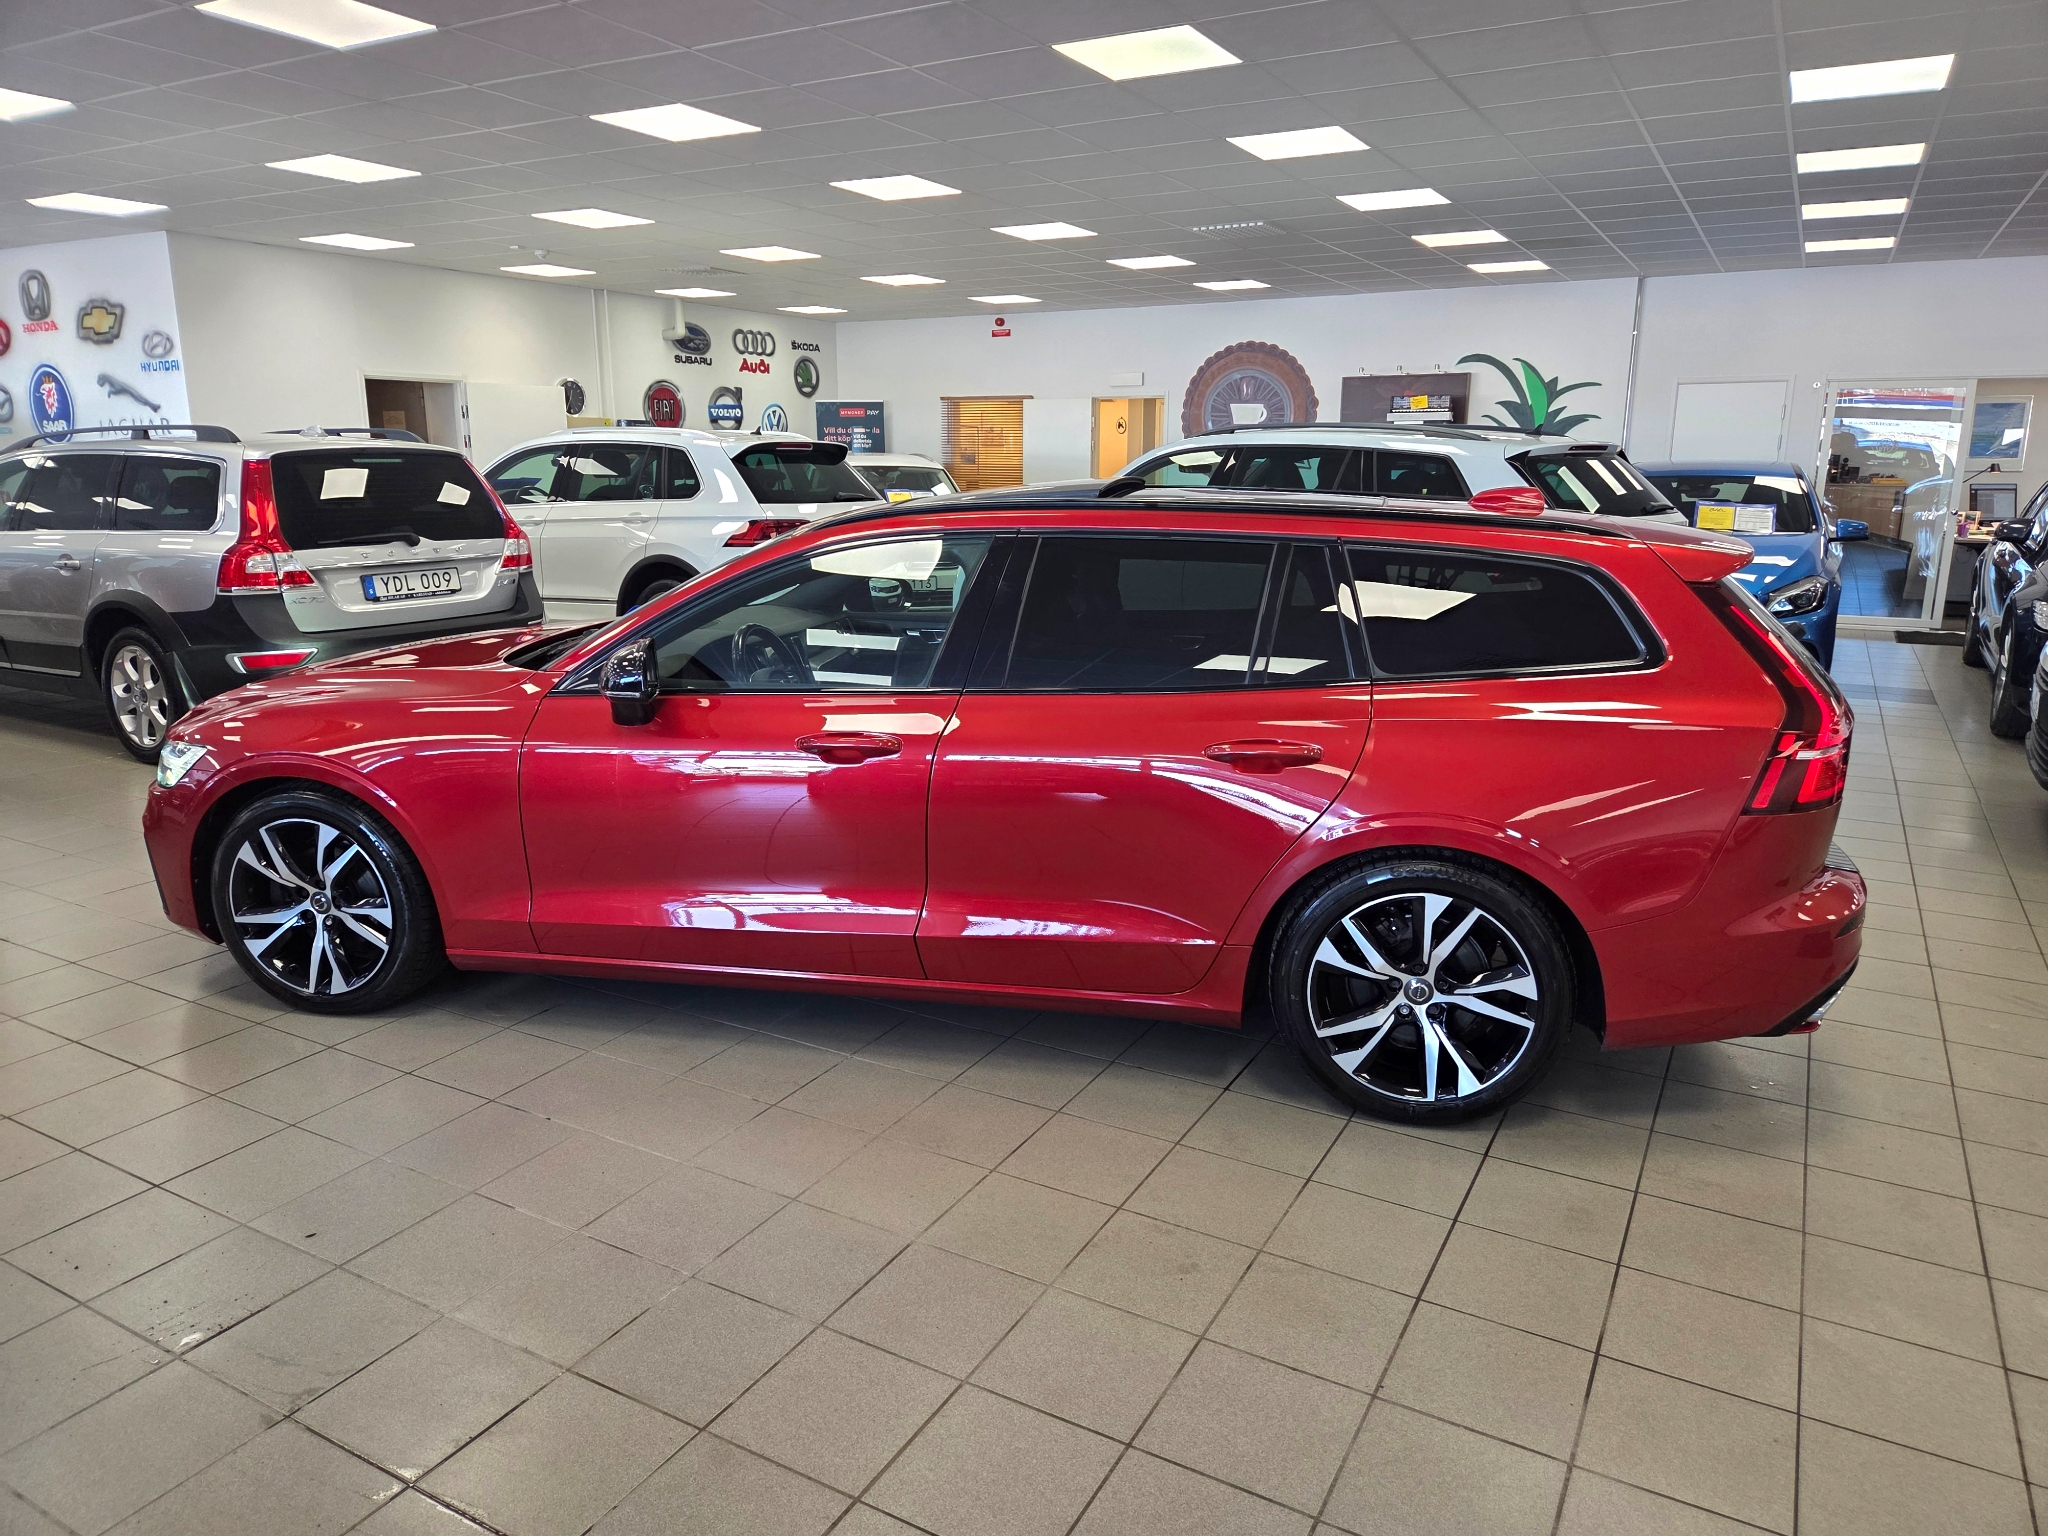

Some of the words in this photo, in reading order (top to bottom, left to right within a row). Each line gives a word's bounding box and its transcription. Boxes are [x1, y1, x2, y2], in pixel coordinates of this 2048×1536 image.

[22, 320, 58, 333] HONDA
[791, 339, 821, 352] ŠKODA
[140, 359, 180, 372] HYUNDAI
[674, 354, 712, 366] SUBARU
[739, 357, 770, 374] Audi
[653, 398, 675, 420] FIAT
[710, 408, 742, 417] VOLVO
[823, 426, 836, 434] Vill
[836, 426, 846, 434] du
[361, 545, 463, 559] VOLVO
[379, 575, 416, 594] YDL
[420, 571, 453, 590] 009
